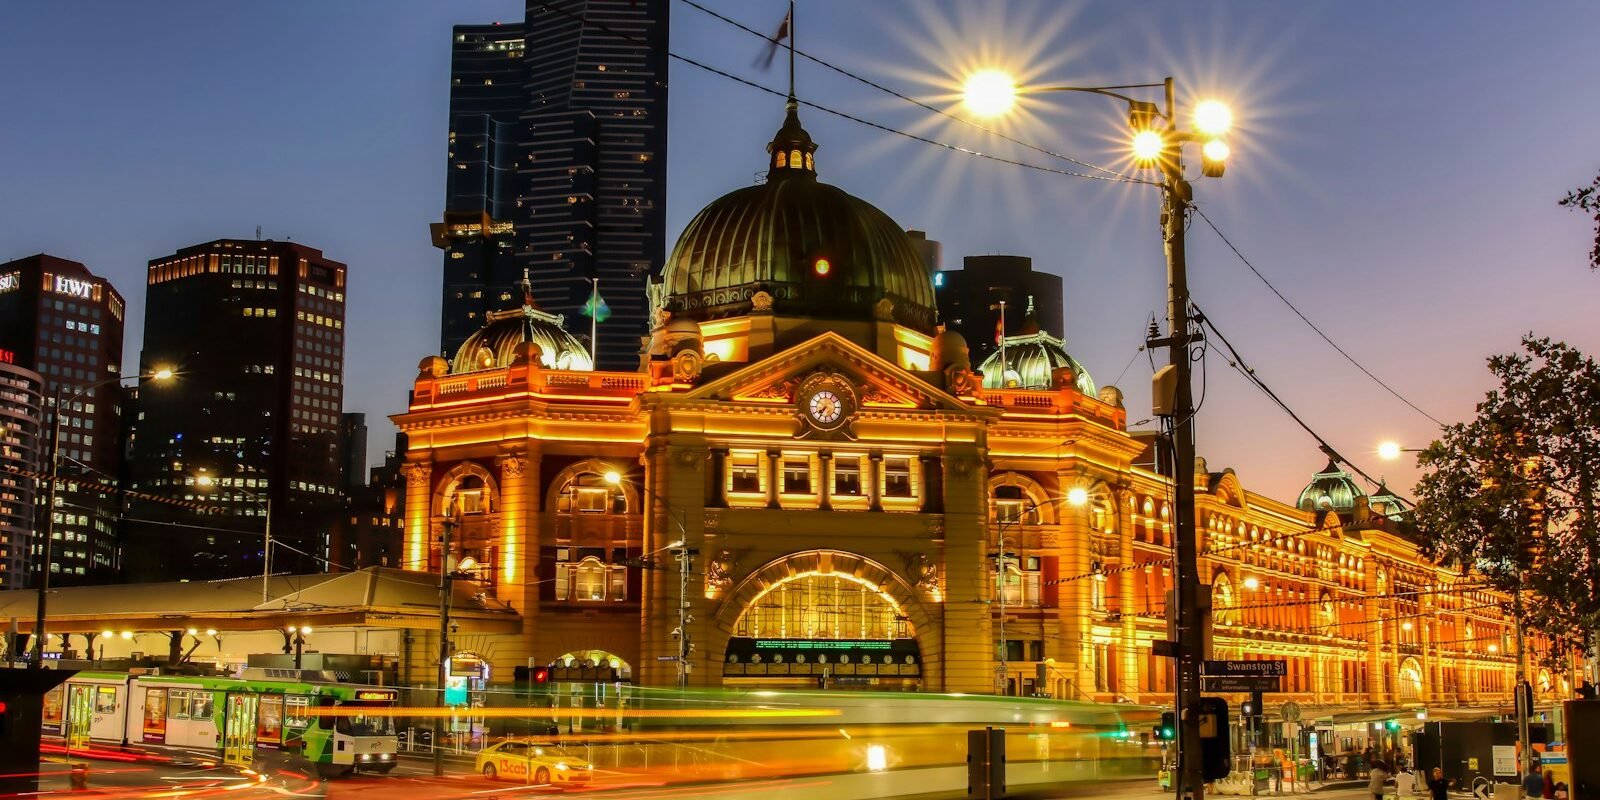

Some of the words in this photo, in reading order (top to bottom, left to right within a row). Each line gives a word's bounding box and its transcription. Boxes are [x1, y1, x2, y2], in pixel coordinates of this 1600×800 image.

[56, 275, 92, 298] HWT
[1227, 661, 1272, 671] Swanston
[1274, 661, 1284, 671] St
